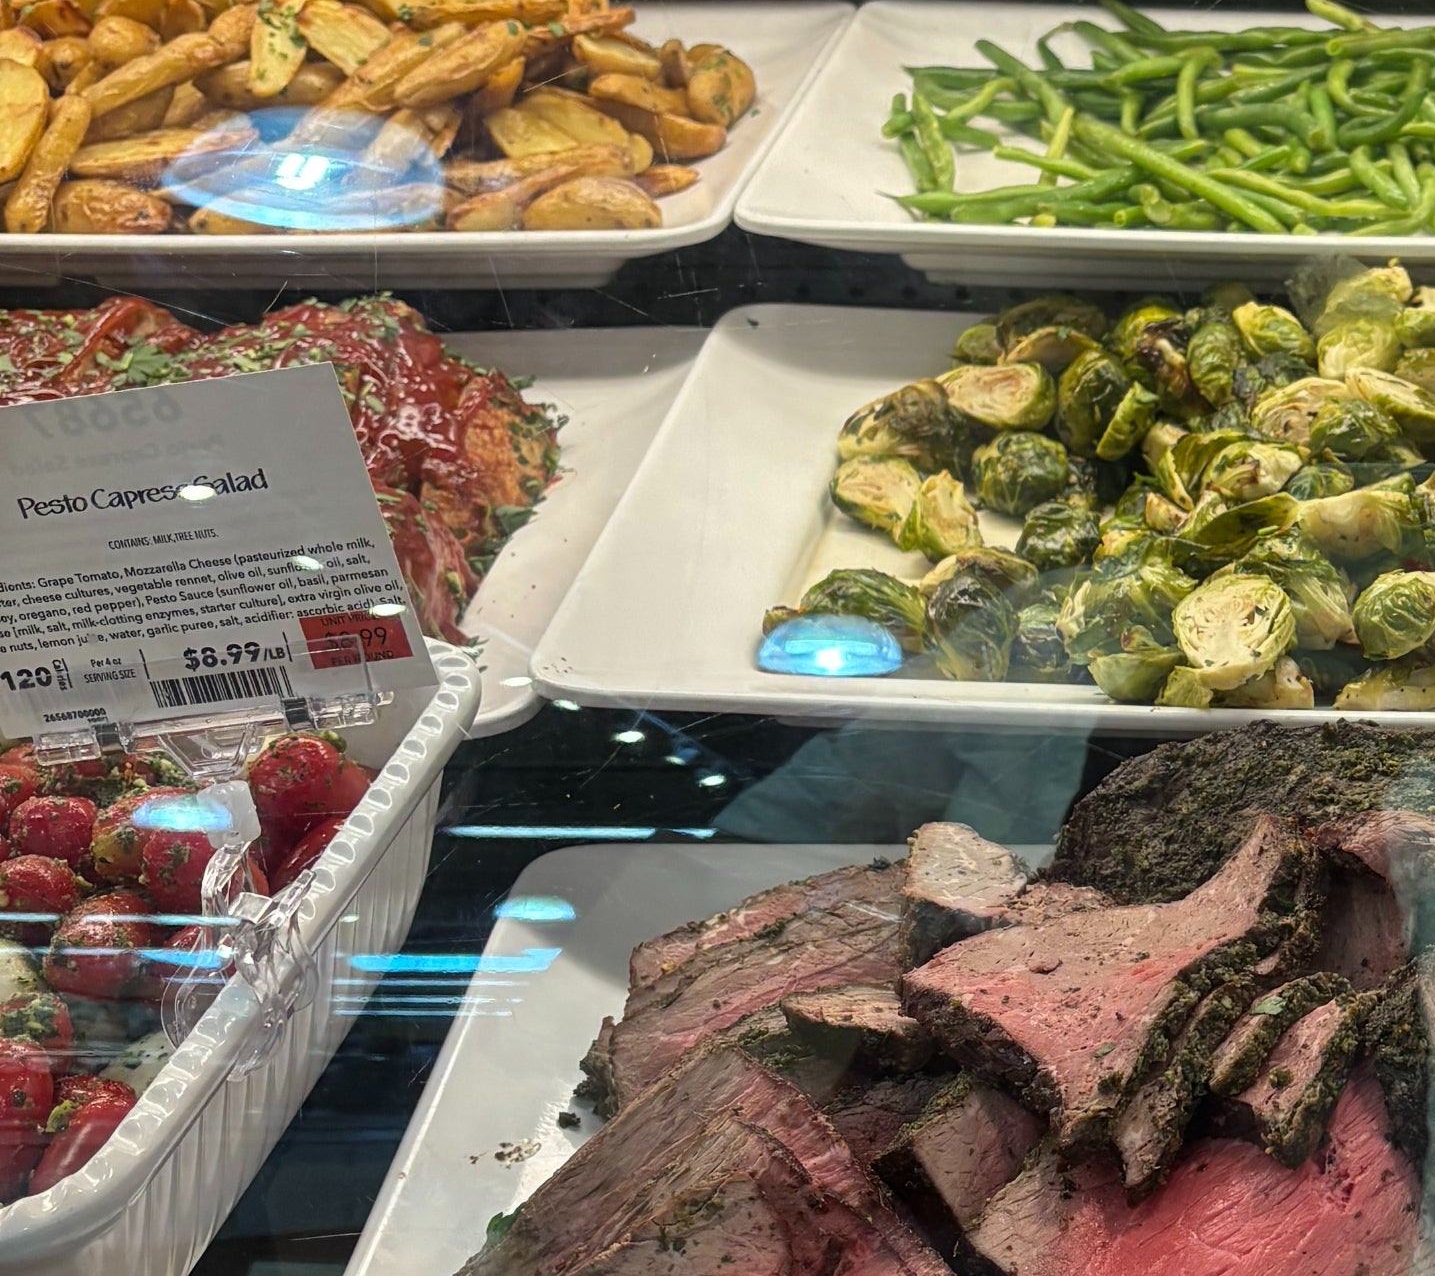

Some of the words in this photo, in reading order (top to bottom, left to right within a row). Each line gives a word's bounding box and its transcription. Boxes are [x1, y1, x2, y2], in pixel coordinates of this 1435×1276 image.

[17, 496, 88, 520] Pesto
[37, 576, 75, 589] Grape
[74, 570, 124, 584] Tomato,
[123, 560, 187, 578] Mozzarella
[188, 557, 232, 570] Cheese
[233, 545, 305, 567] (pasteurized
[307, 540, 344, 555] whole
[346, 537, 375, 550] milk,
[108, 537, 152, 550] CONTAINS:
[19, 608, 71, 622] oregano,
[72, 603, 92, 615] red
[94, 596, 145, 615] pepper),
[145, 594, 178, 605] Pesto
[178, 590, 215, 602] Sauce
[215, 581, 275, 599] (sunflower
[278, 577, 297, 591] oil,
[298, 573, 329, 589] basil,
[331, 567, 388, 586] parmesan
[22, 593, 63, 605] cheese
[64, 587, 114, 601] cultures,
[114, 577, 173, 595] vegetable
[175, 573, 216, 587] rennet,
[217, 570, 245, 582] olive
[247, 566, 267, 579] oil,
[326, 556, 345, 568] oil,
[346, 553, 371, 566] salt,
[9, 641, 38, 652] nuts,
[37, 637, 75, 649] lemon
[108, 628, 146, 641] water,
[146, 623, 180, 638] garlic
[180, 620, 218, 635] puree,
[219, 615, 244, 627] salt,
[244, 610, 294, 625] acidifier:
[296, 603, 346, 618] ascorbic
[46, 621, 71, 633] salt,
[71, 613, 143, 630] milk-clotting
[145, 607, 199, 622] enzymes,
[200, 601, 237, 614] starter
[287, 590, 317, 604] extra
[317, 585, 351, 601] virgin
[353, 581, 382, 595] olive
[384, 580, 405, 593] oil,
[0, 666, 53, 692] 120
[90, 658, 104, 668] Per
[84, 670, 118, 684] SERVING
[119, 668, 136, 680] SIZE
